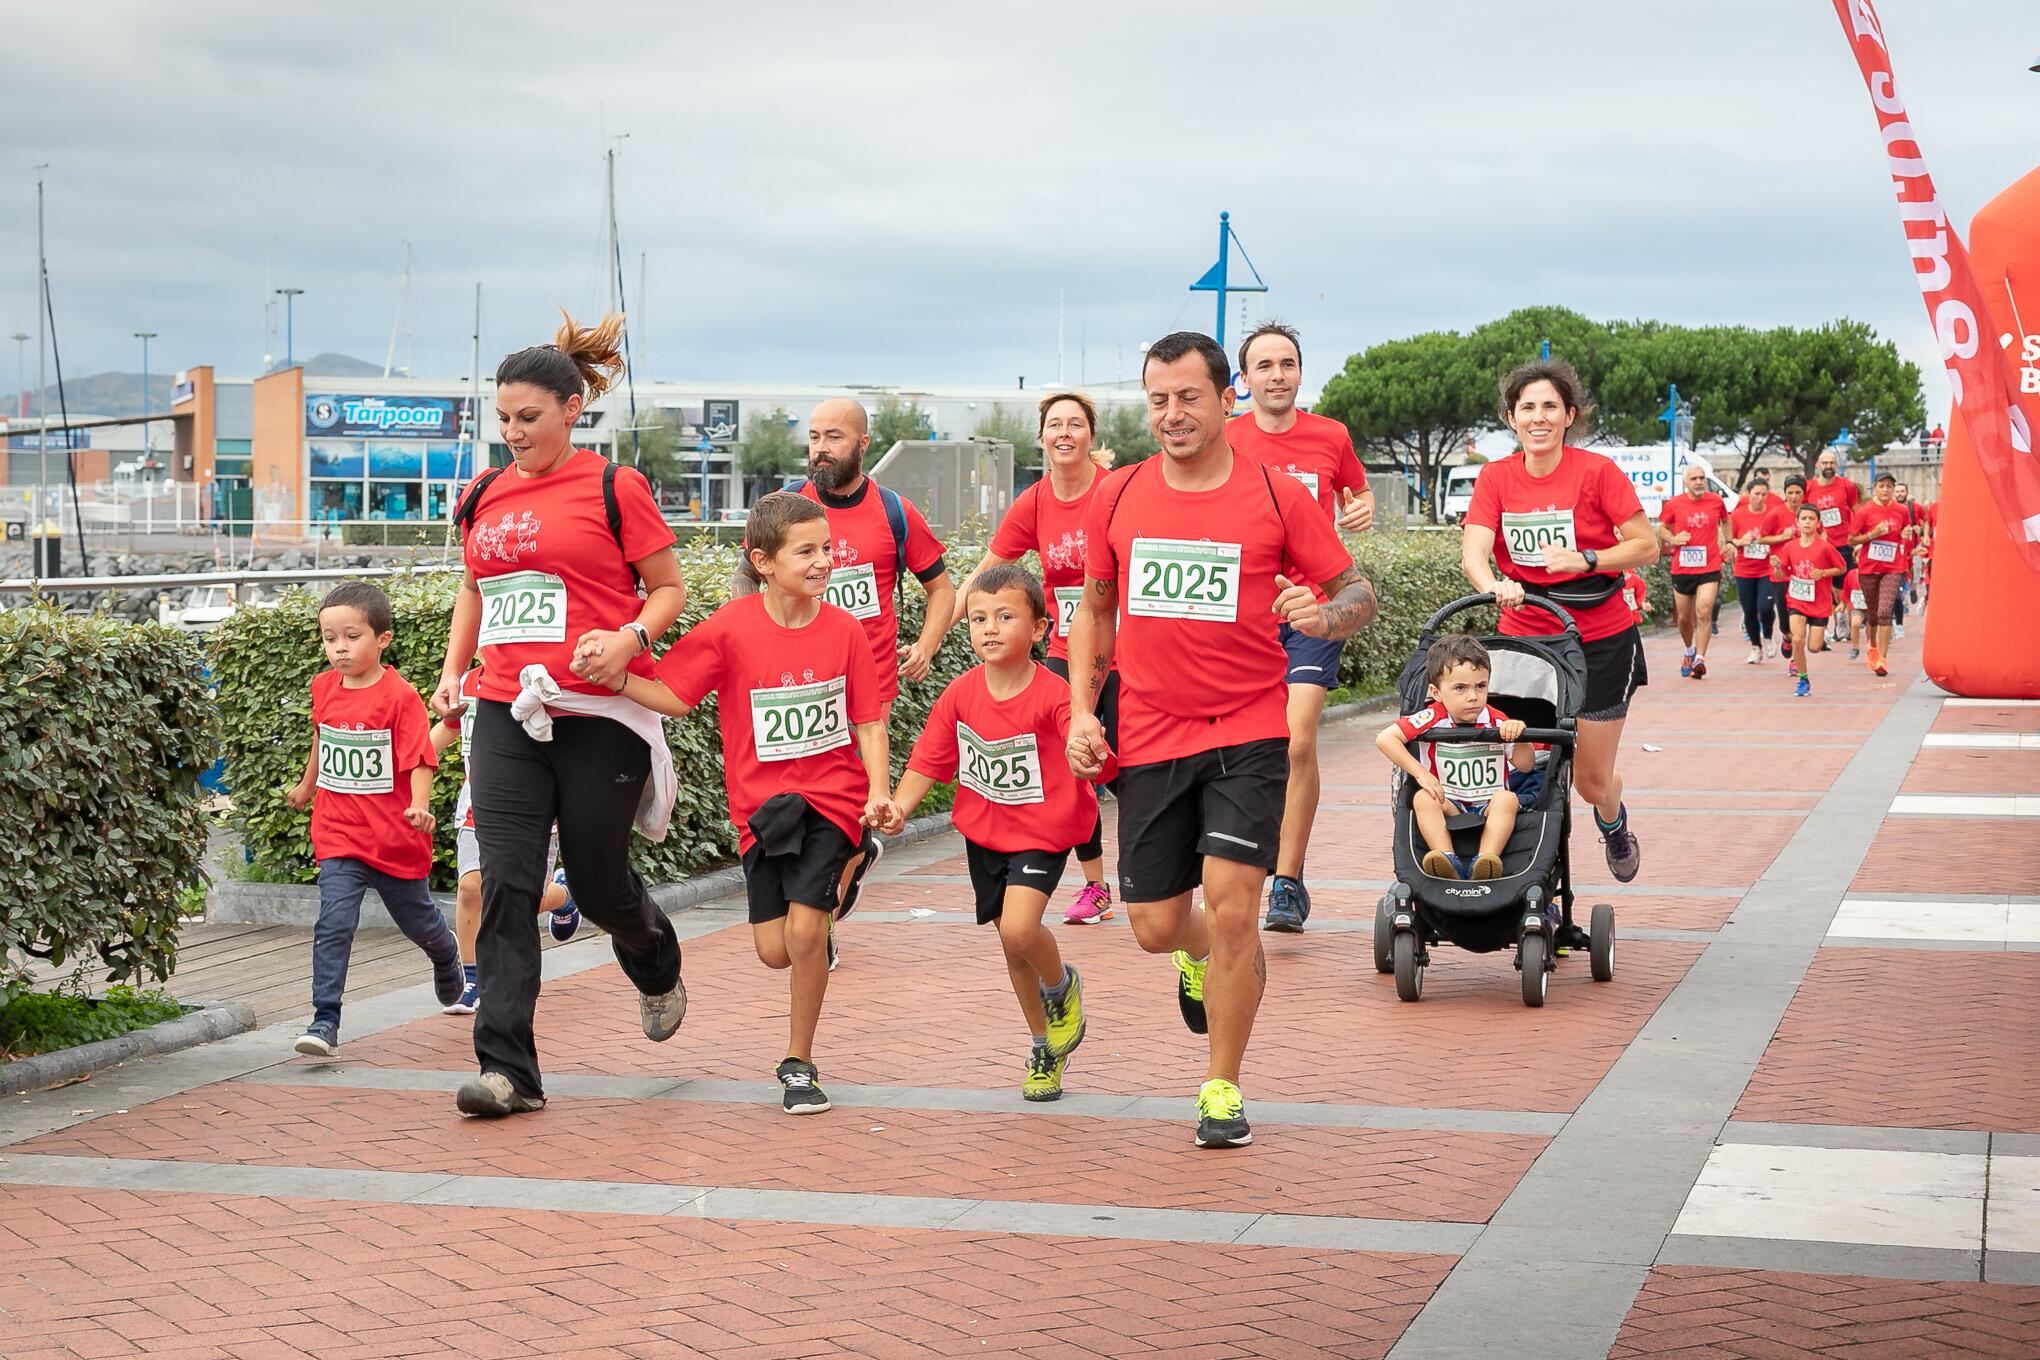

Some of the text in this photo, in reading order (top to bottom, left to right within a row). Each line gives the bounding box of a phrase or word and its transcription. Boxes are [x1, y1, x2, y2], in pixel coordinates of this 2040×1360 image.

[2021, 334, 2040, 361] S
[2020, 366, 2040, 394] B
[343, 402, 443, 429] Tarpoon
[1626, 470, 1668, 487] rgo
[1510, 527, 1567, 553] 2005
[822, 580, 871, 609] 003
[1141, 561, 1228, 602] 2025
[487, 591, 556, 629] 2025
[764, 698, 839, 742] 2025
[322, 743, 383, 778] 2003
[967, 744, 1031, 788] 2025
[1443, 758, 1497, 788] 2005
